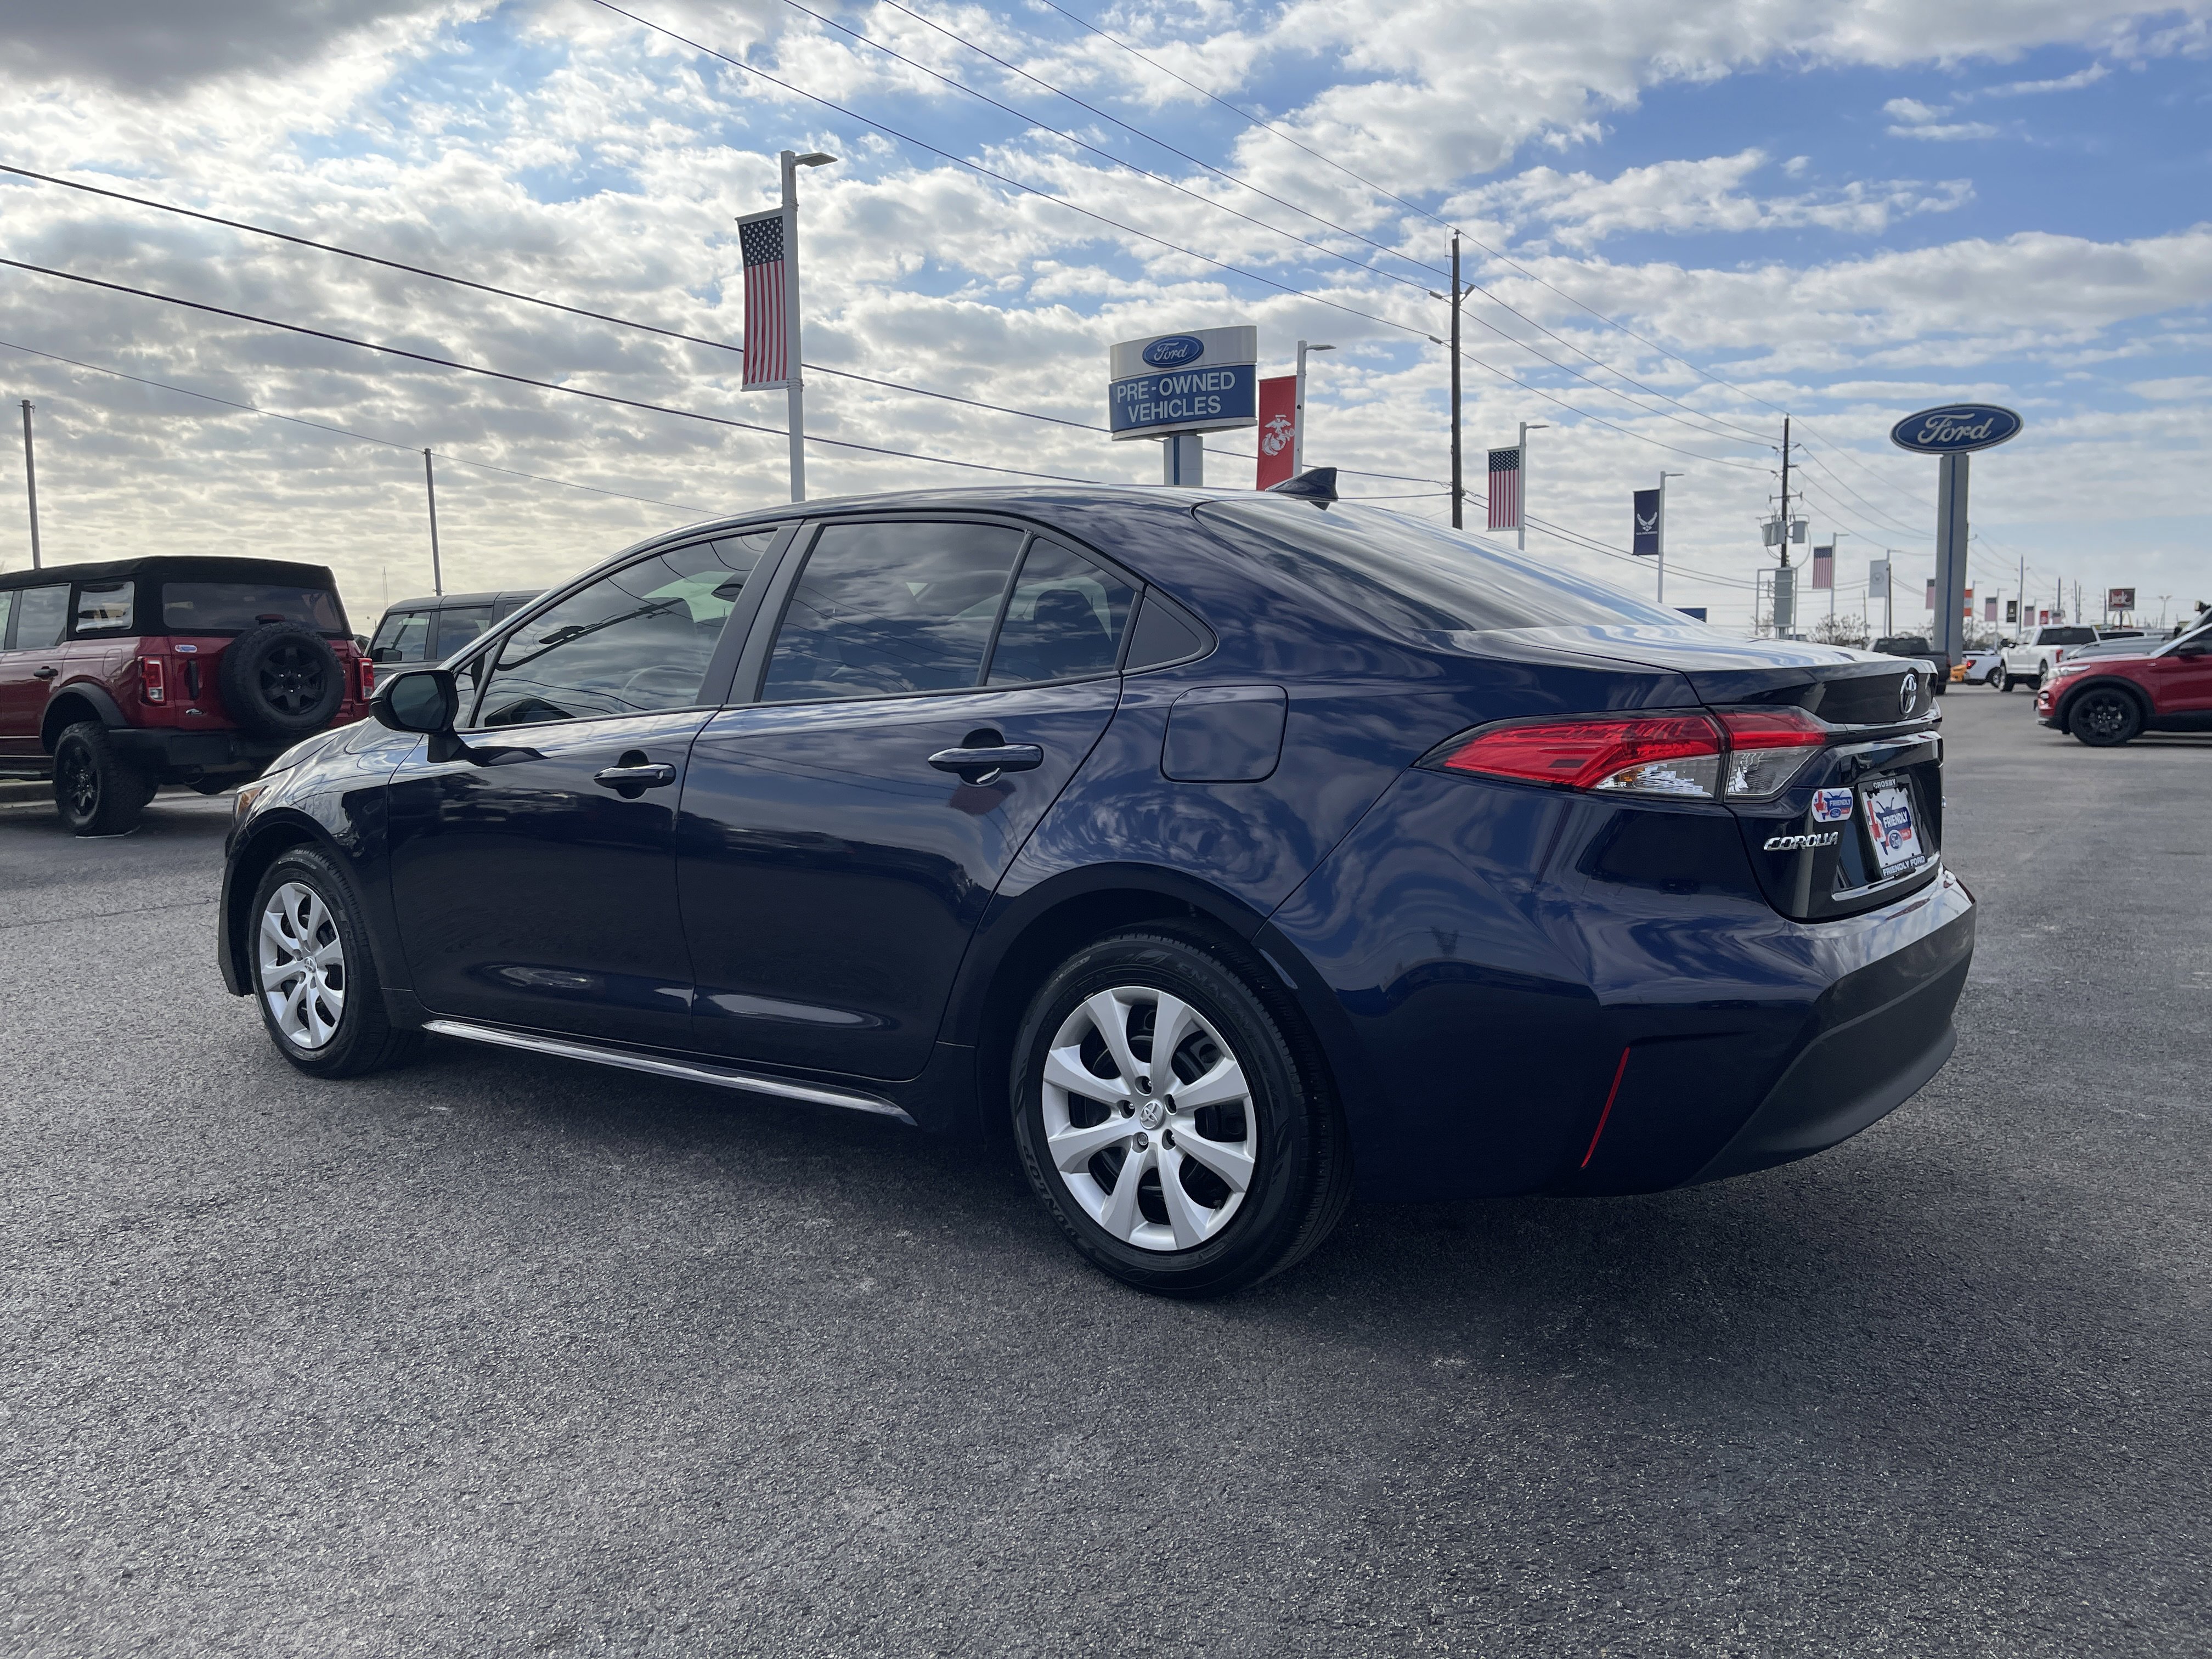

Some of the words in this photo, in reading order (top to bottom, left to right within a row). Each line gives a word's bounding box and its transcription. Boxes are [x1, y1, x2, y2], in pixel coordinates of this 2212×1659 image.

[1154, 342, 1188, 361] Ford
[1117, 371, 1235, 403] PRE-OWNED
[1128, 396, 1221, 422] VEHICLES
[1917, 413, 1994, 444] Ford
[1873, 778, 1897, 789] CROSBY
[1883, 811, 1908, 828] FRIENDLY
[1764, 831, 1838, 851] COROLLA
[1882, 860, 1910, 876] FRIENDLY
[1910, 855, 1925, 868] FORD
[1023, 1144, 1080, 1240] DUNLOP
